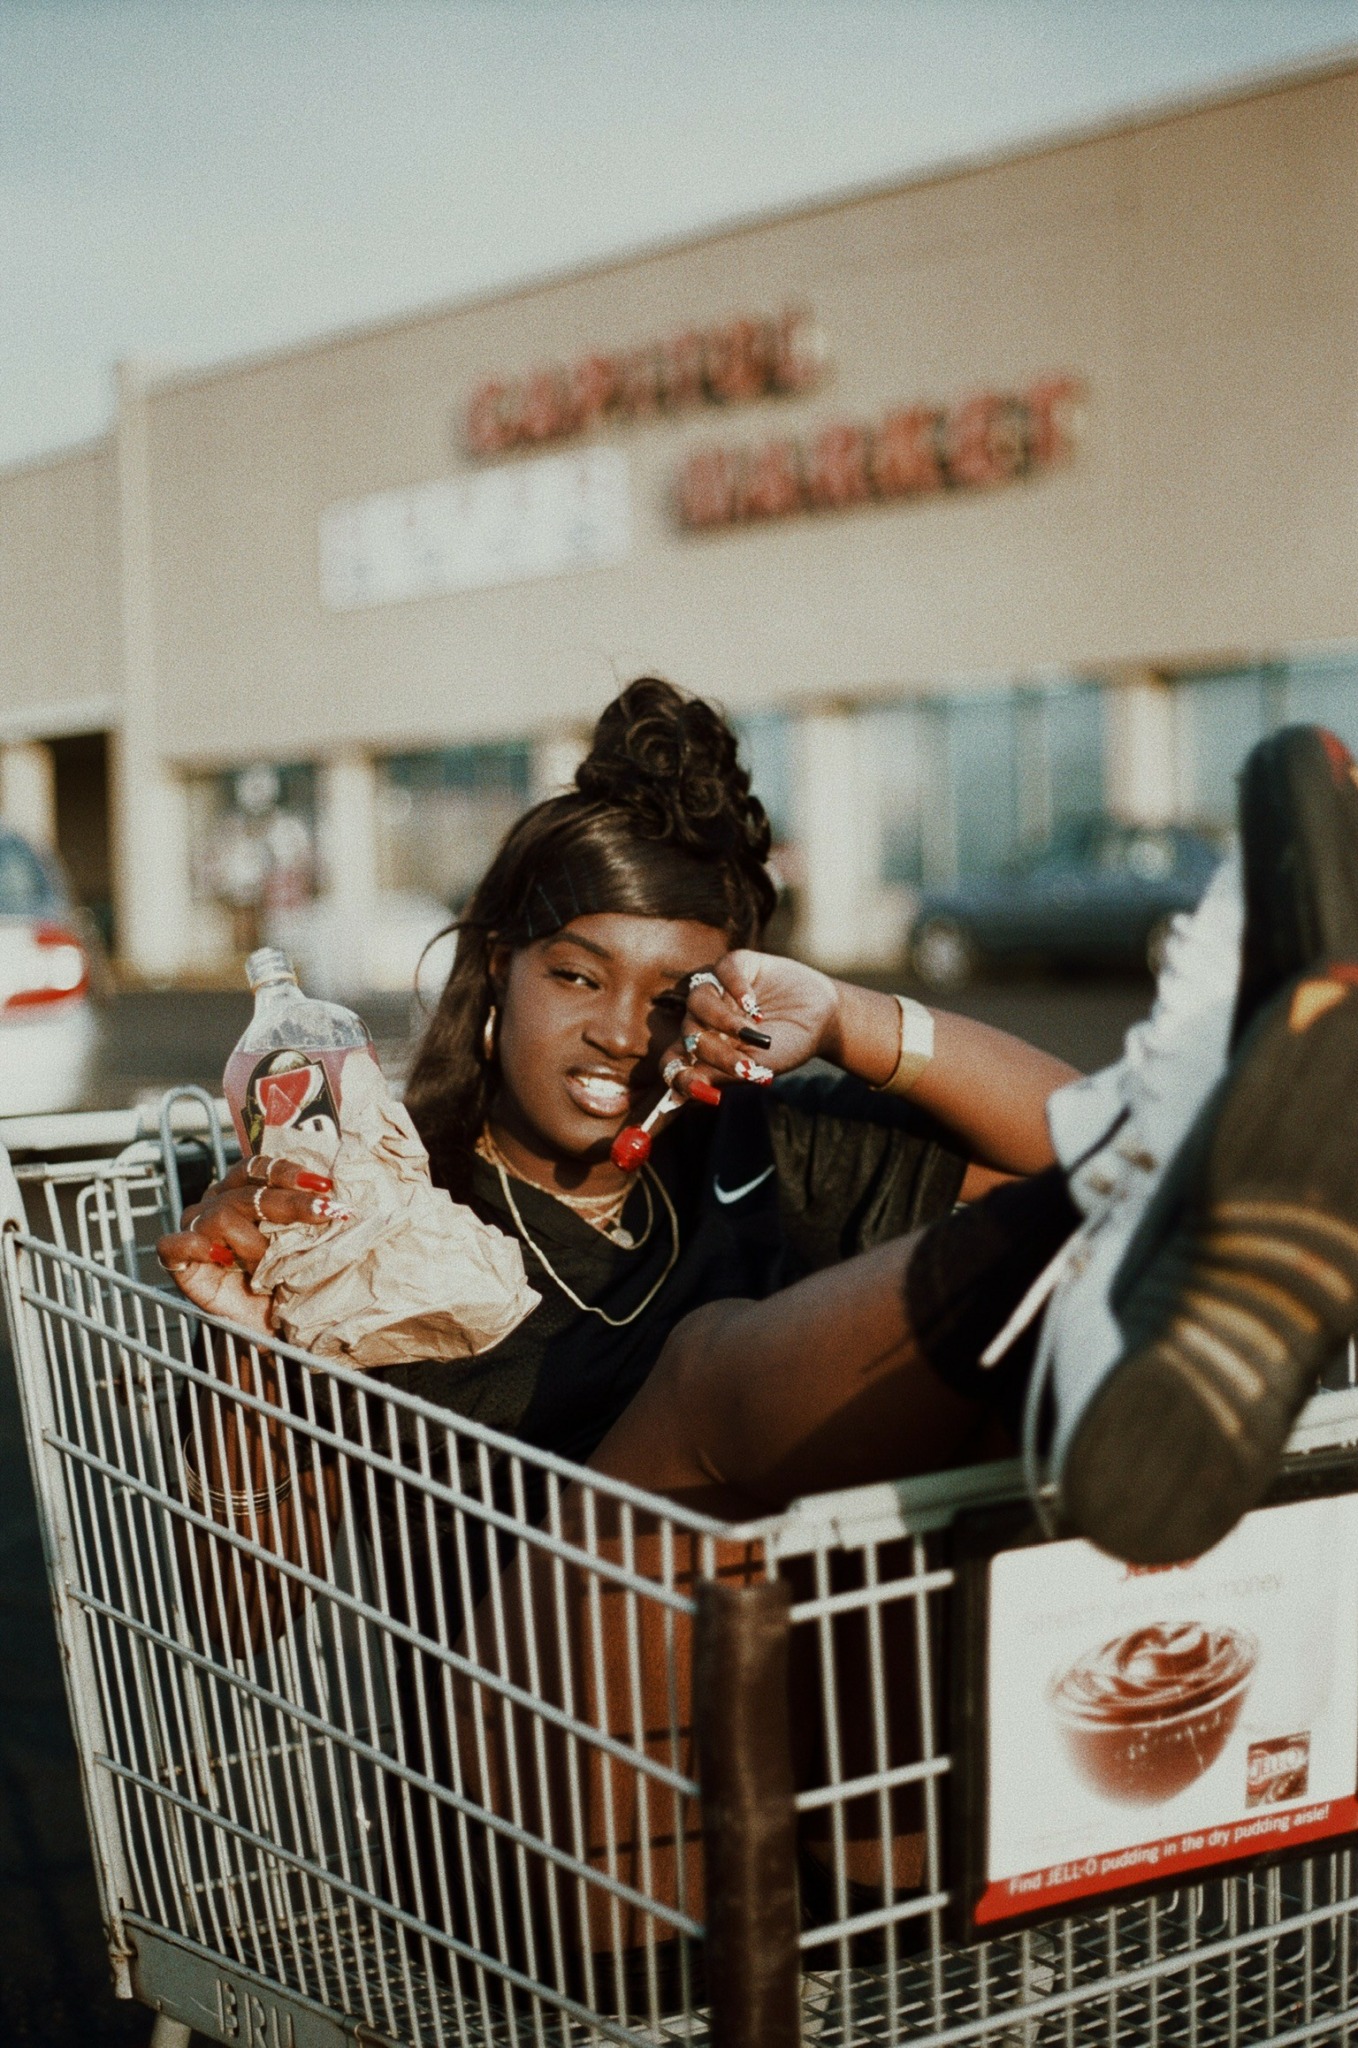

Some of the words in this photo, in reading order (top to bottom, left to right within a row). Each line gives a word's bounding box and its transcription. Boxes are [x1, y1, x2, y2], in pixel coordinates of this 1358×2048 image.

[1009, 1872, 1042, 1896] Find
[1047, 1857, 1098, 1887] JELL-O
[1101, 1846, 1159, 1876] pudding
[1162, 1841, 1178, 1857] in
[1182, 1834, 1205, 1853] the
[1208, 1830, 1230, 1848] dry
[1234, 1816, 1290, 1843] pudding
[1293, 1804, 1330, 1826] aisle!
